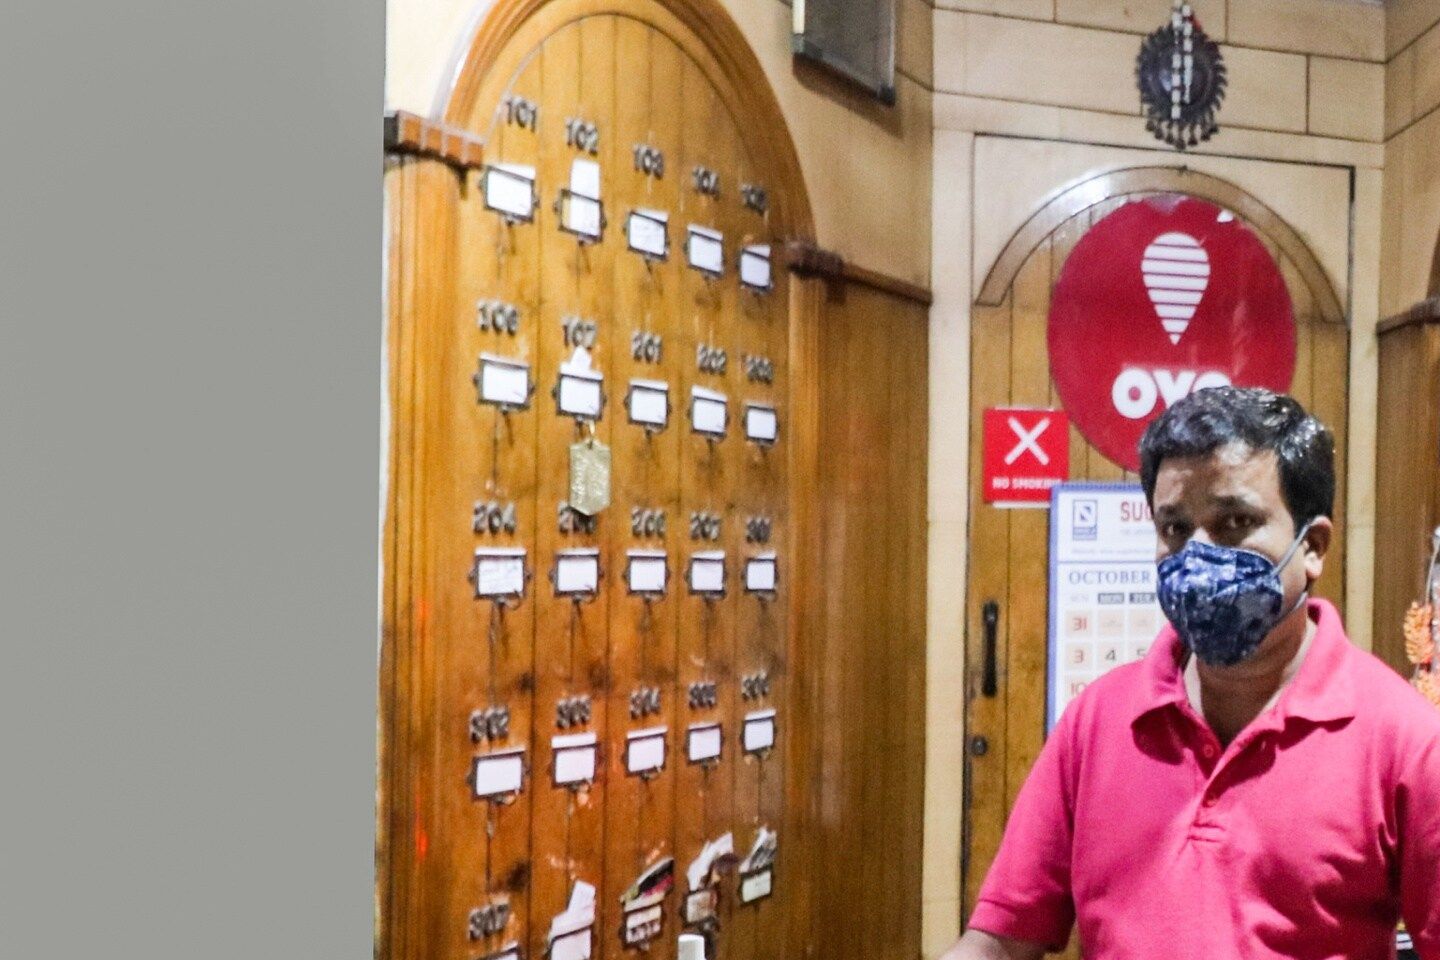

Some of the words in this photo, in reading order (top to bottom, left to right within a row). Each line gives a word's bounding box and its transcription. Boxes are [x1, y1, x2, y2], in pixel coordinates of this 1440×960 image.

[503, 95, 538, 133] 101
[565, 116, 598, 156] 102
[560, 316, 597, 351] 107
[631, 328, 663, 365] 201
[1068, 570, 1151, 585] OCTOBER
[1072, 616, 1087, 632] 31
[1073, 648, 1084, 664] 3
[1104, 648, 1116, 662] 4
